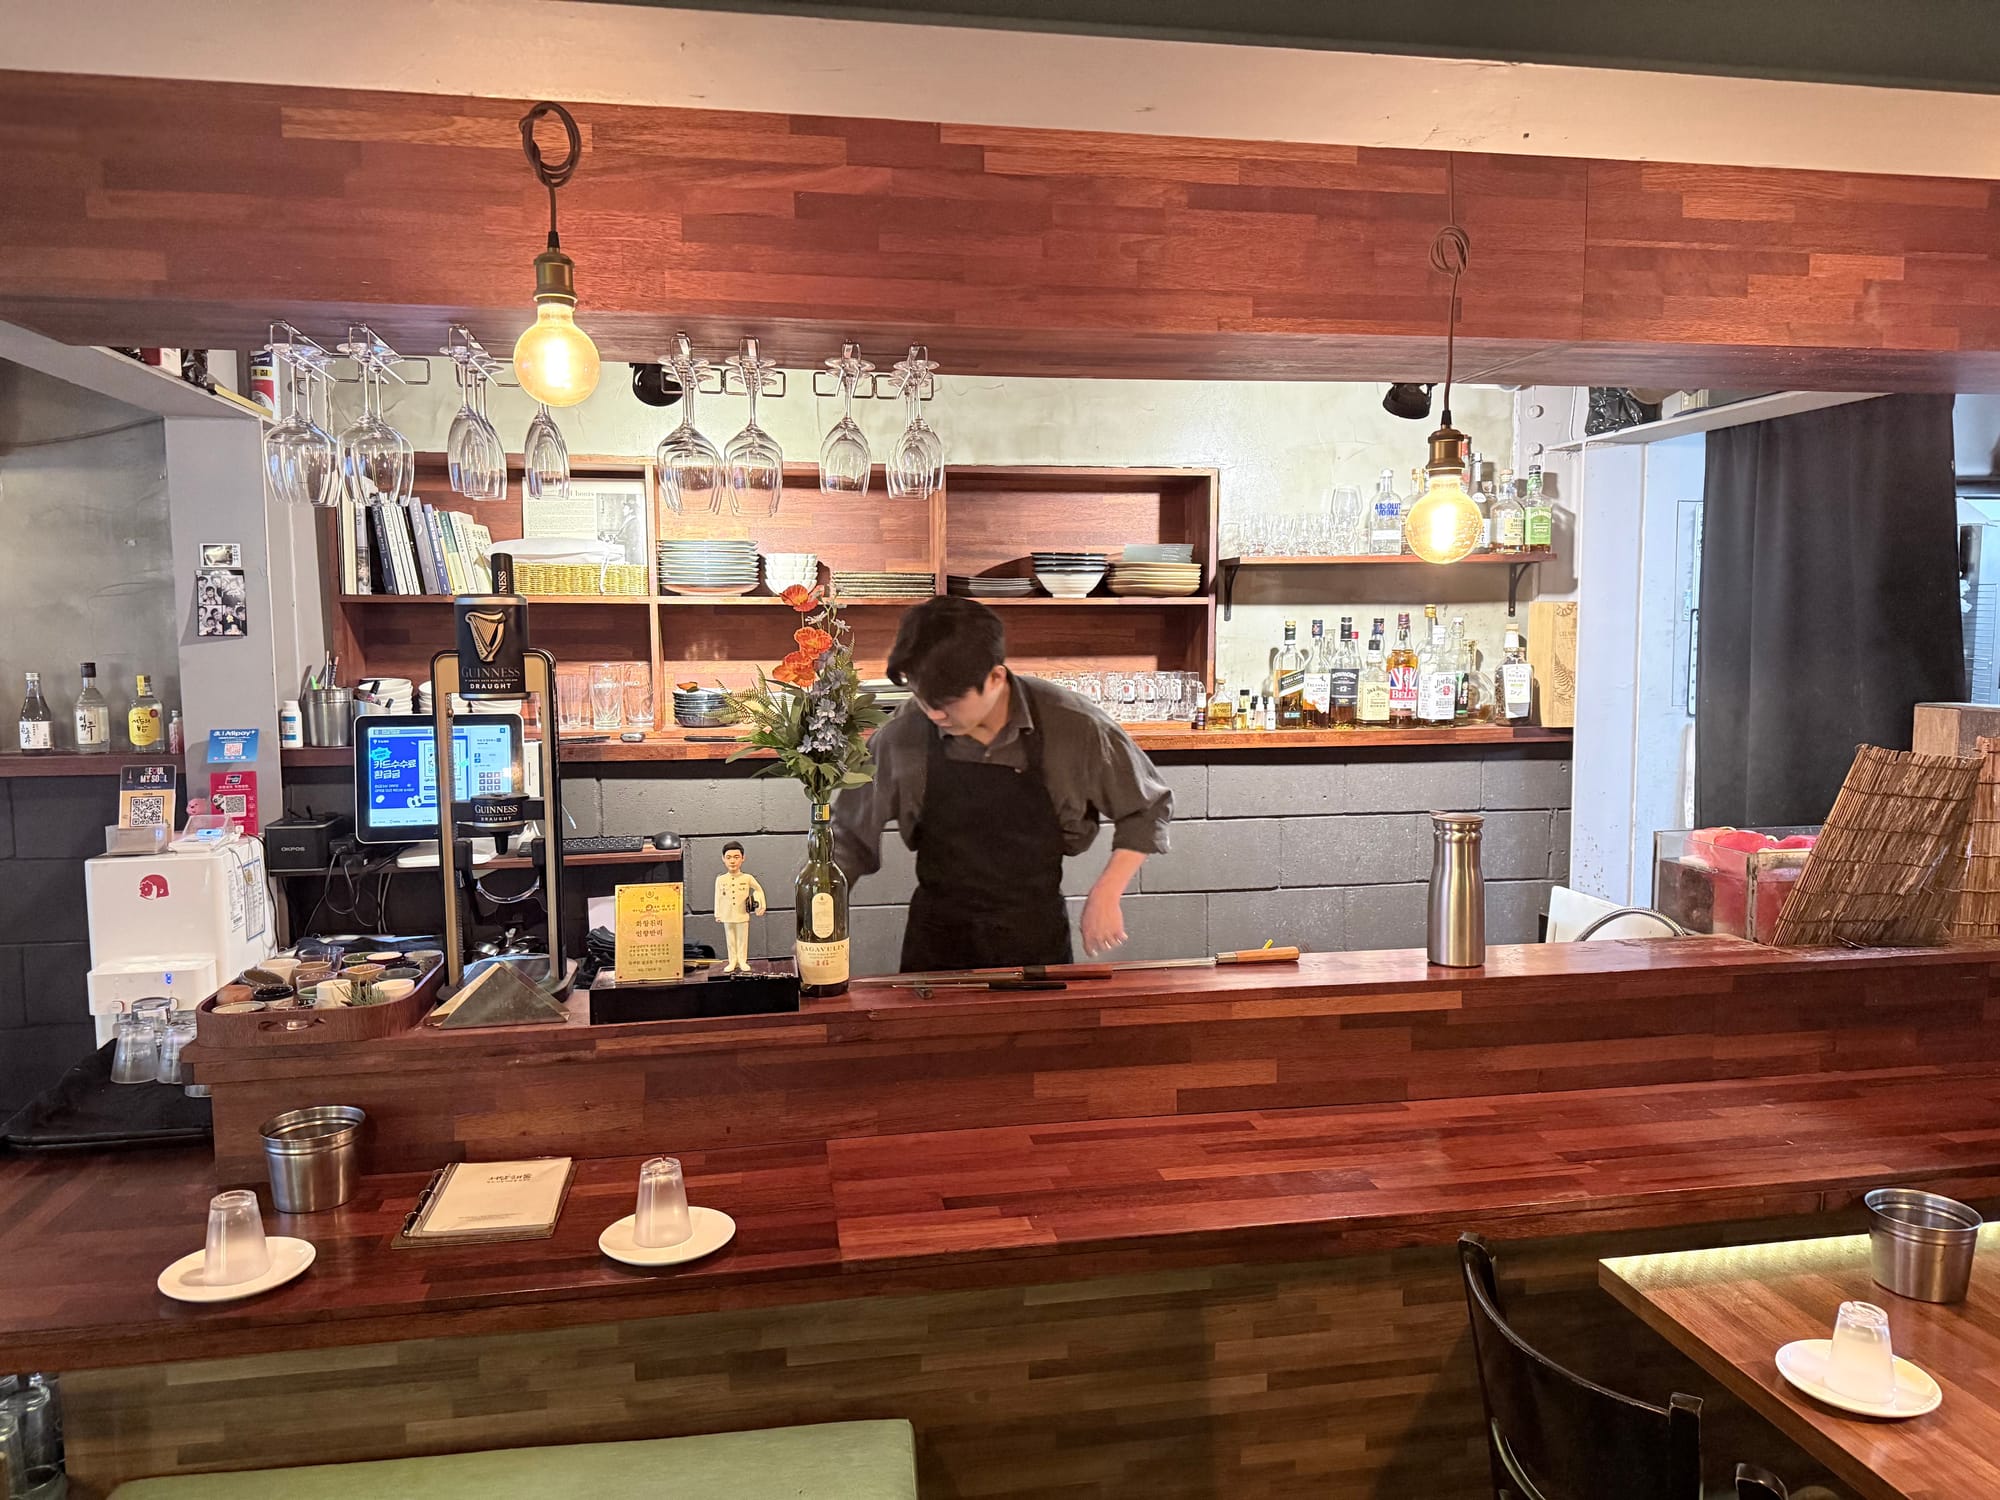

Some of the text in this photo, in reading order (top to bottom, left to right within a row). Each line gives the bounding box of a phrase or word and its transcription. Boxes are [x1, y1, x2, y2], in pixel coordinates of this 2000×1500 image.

[462, 667, 520, 678] GUINNESS
[374, 759, 416, 768] 카드수수료
[475, 805, 518, 814] GUINNESS
[800, 944, 845, 953] LAGAVULIN
